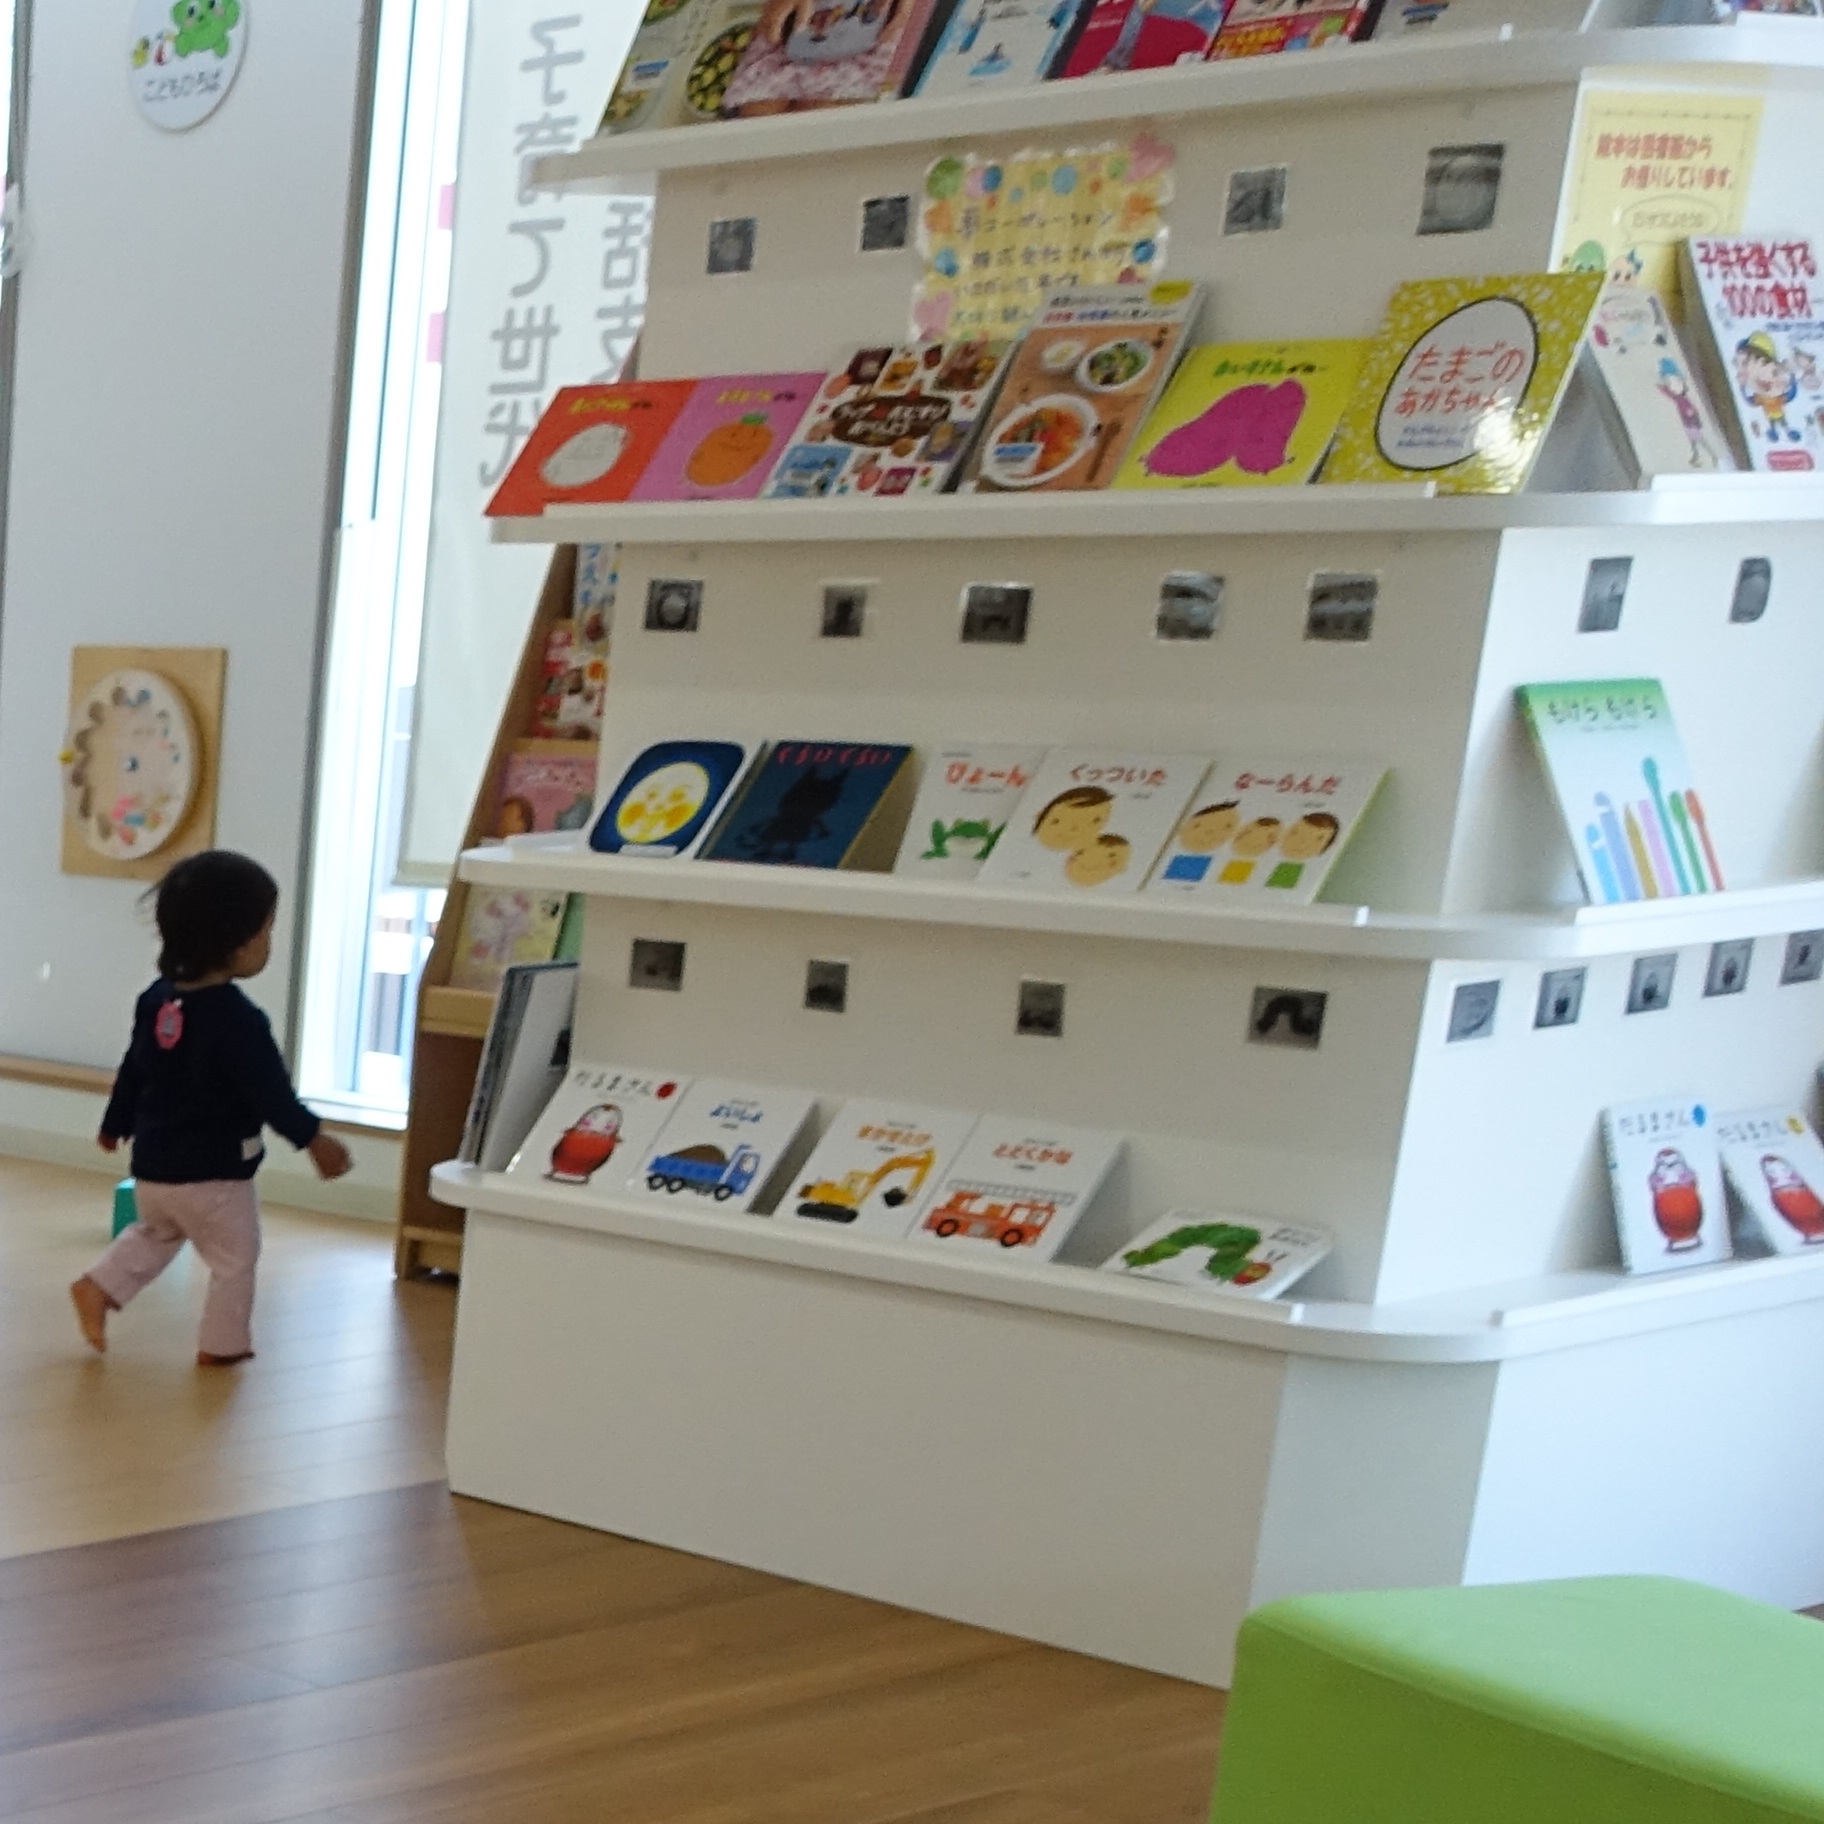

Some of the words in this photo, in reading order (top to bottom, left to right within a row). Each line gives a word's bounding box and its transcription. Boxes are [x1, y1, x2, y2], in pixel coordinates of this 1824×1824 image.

[1408, 340, 1525, 385] たまごの
[1069, 763, 1167, 787] くっついた
